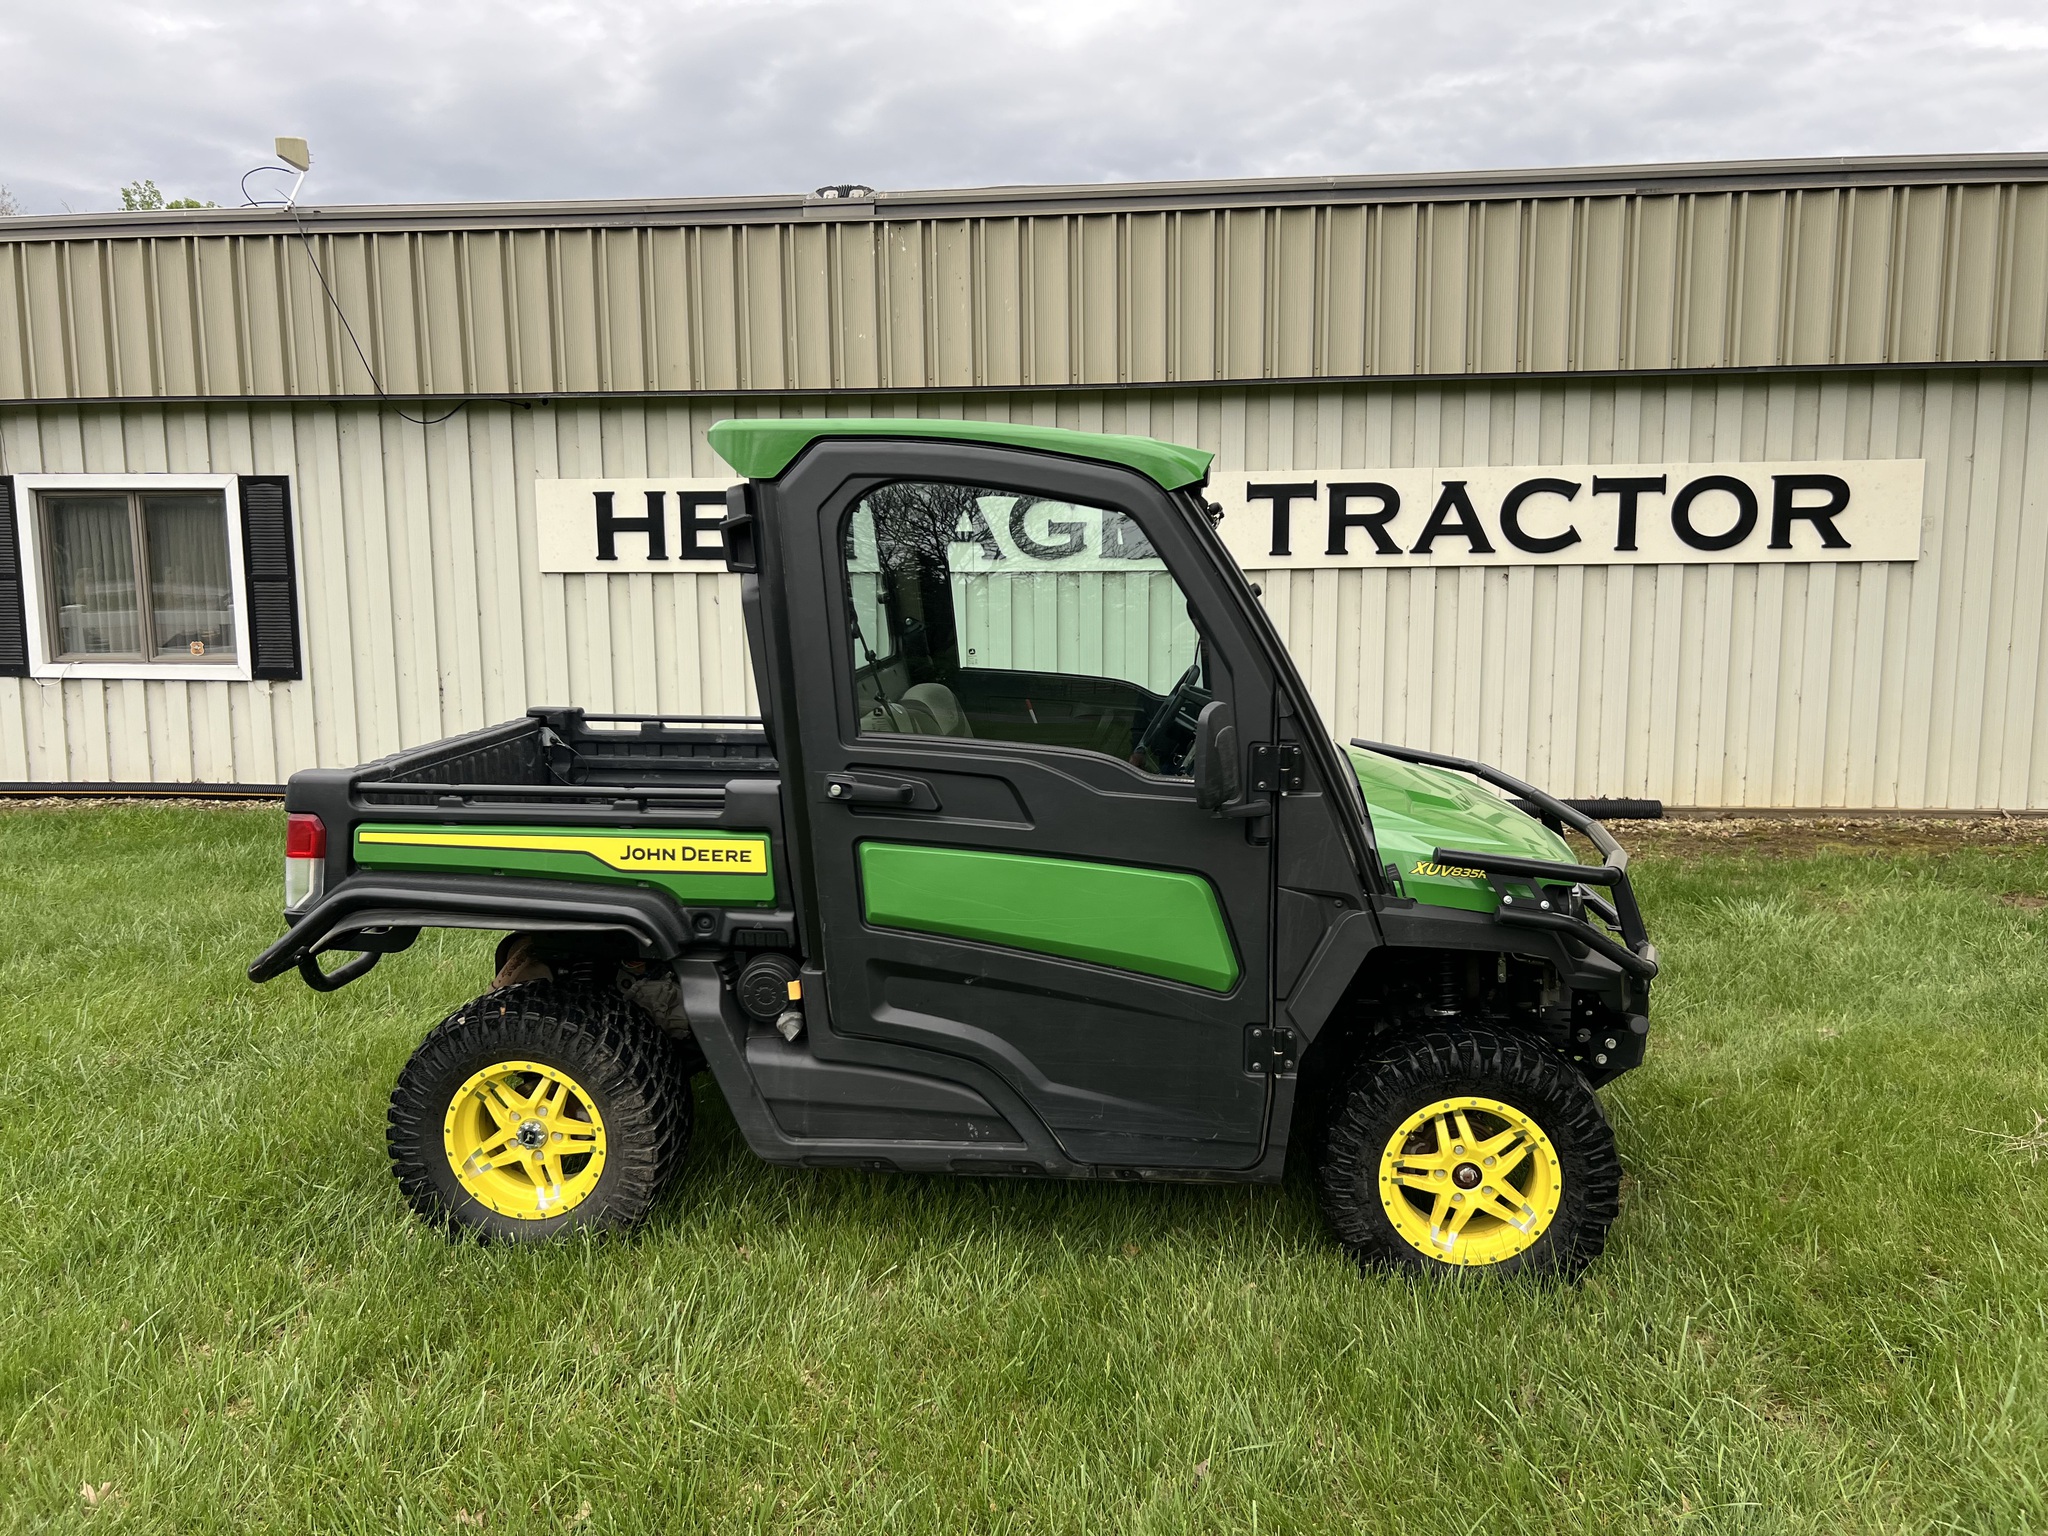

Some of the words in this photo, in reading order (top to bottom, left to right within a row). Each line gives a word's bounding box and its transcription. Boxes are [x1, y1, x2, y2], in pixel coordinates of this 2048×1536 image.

[592, 490, 1160, 561] HEAGE
[1246, 474, 1852, 556] TRACTOR
[620, 845, 676, 861] JOHN
[682, 846, 752, 863] DEERE
